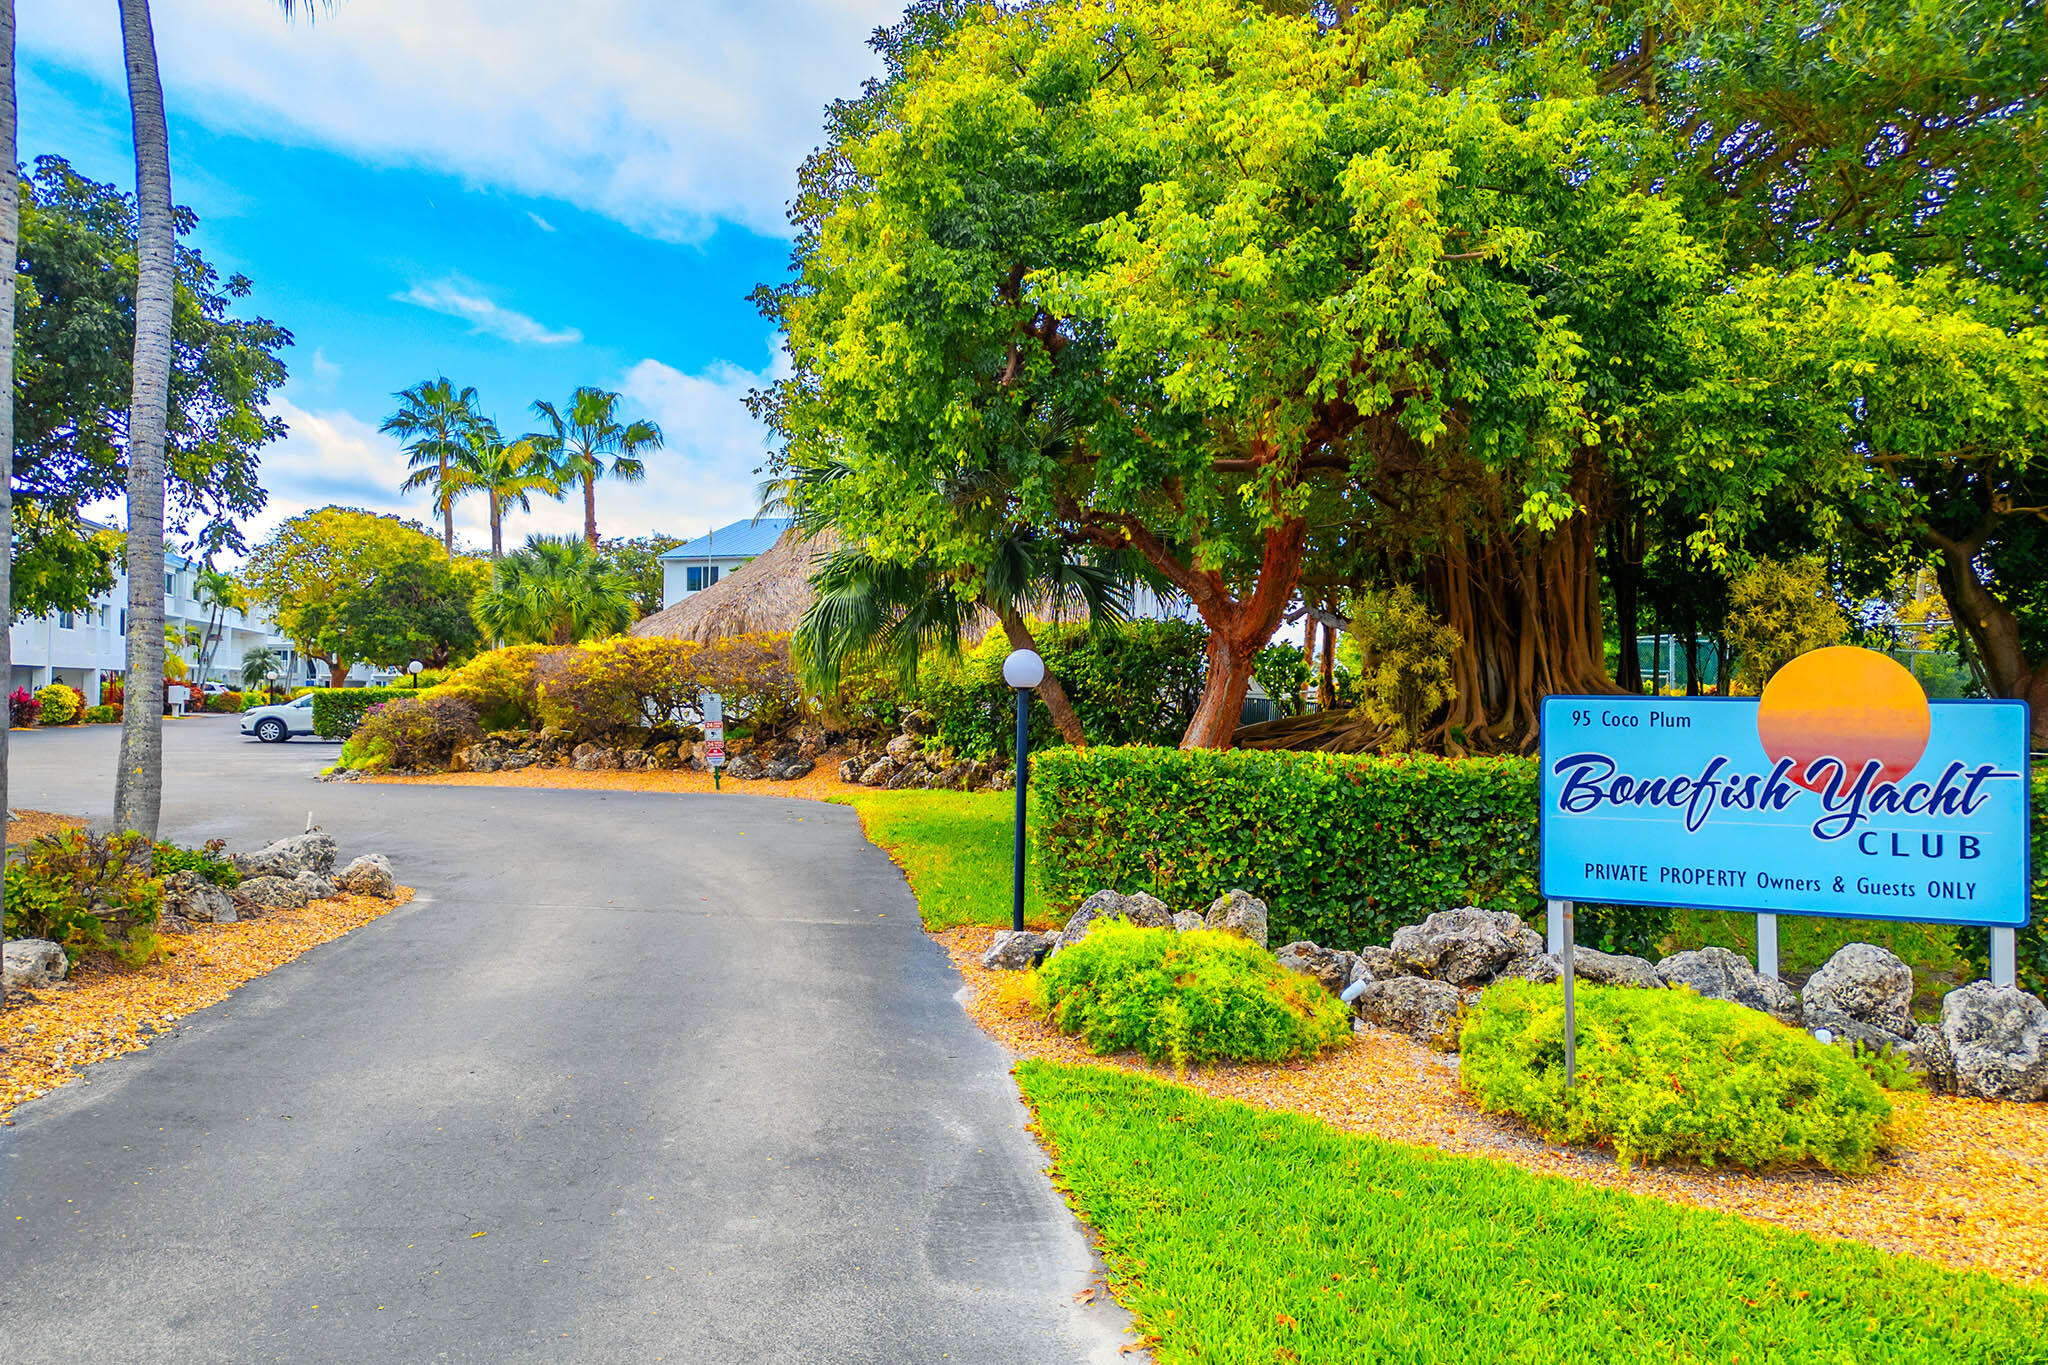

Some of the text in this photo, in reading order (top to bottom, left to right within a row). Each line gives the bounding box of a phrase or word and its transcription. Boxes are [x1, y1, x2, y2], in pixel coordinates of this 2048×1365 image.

[1572, 710, 1691, 728] 95 Coco Plum
[1554, 753, 2020, 841] Bonefish Yacht
[1858, 831, 1981, 860] CLUB
[1585, 863, 1977, 900] PRIVATE PROPERTY Owners & Guests ONLY
